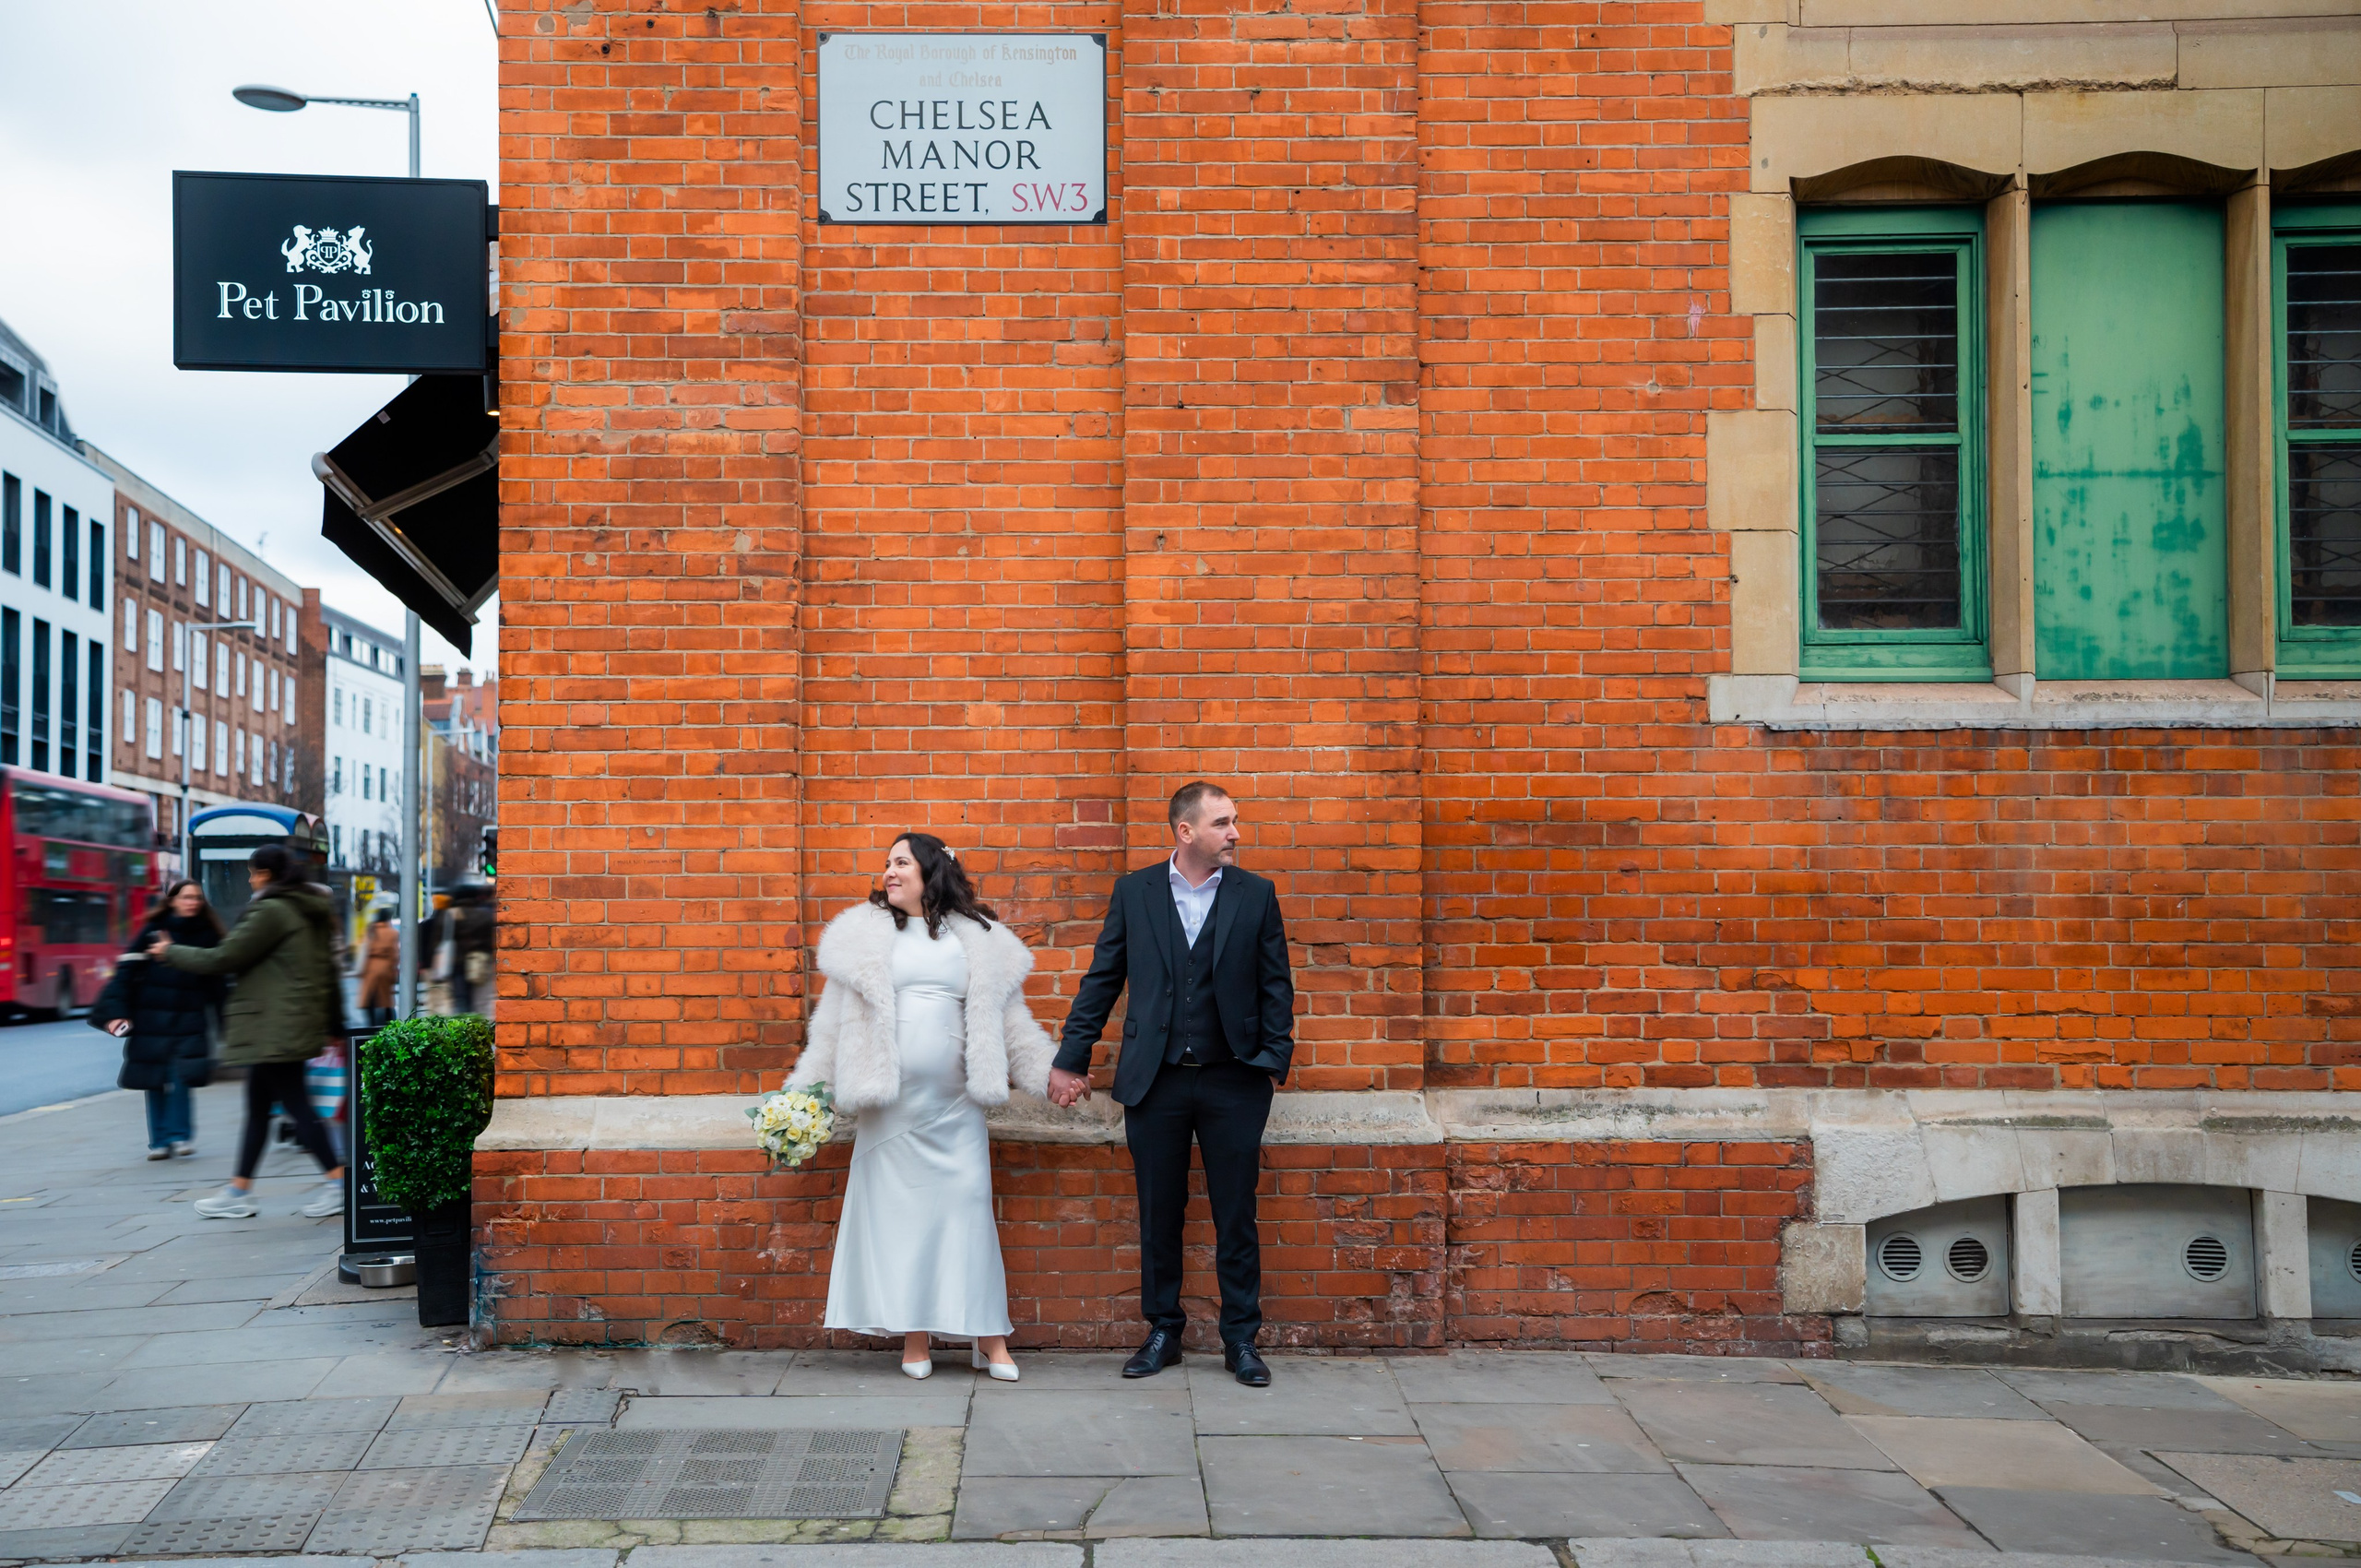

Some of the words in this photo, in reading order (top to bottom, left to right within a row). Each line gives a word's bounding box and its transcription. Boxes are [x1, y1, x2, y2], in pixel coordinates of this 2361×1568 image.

[844, 43, 871, 61] The
[875, 43, 915, 65] Royal
[919, 43, 977, 65] Borough
[982, 43, 998, 60] of
[1002, 42, 1077, 65] Kensington
[919, 71, 943, 88] and
[949, 70, 1003, 88] Chelsea
[870, 100, 1052, 130] CHELSEA
[881, 140, 1042, 170] MANOR
[846, 182, 989, 216] STREET,
[1012, 183, 1088, 213] S.W.3
[216, 281, 279, 320] Pet
[292, 283, 445, 324] Pavilion
